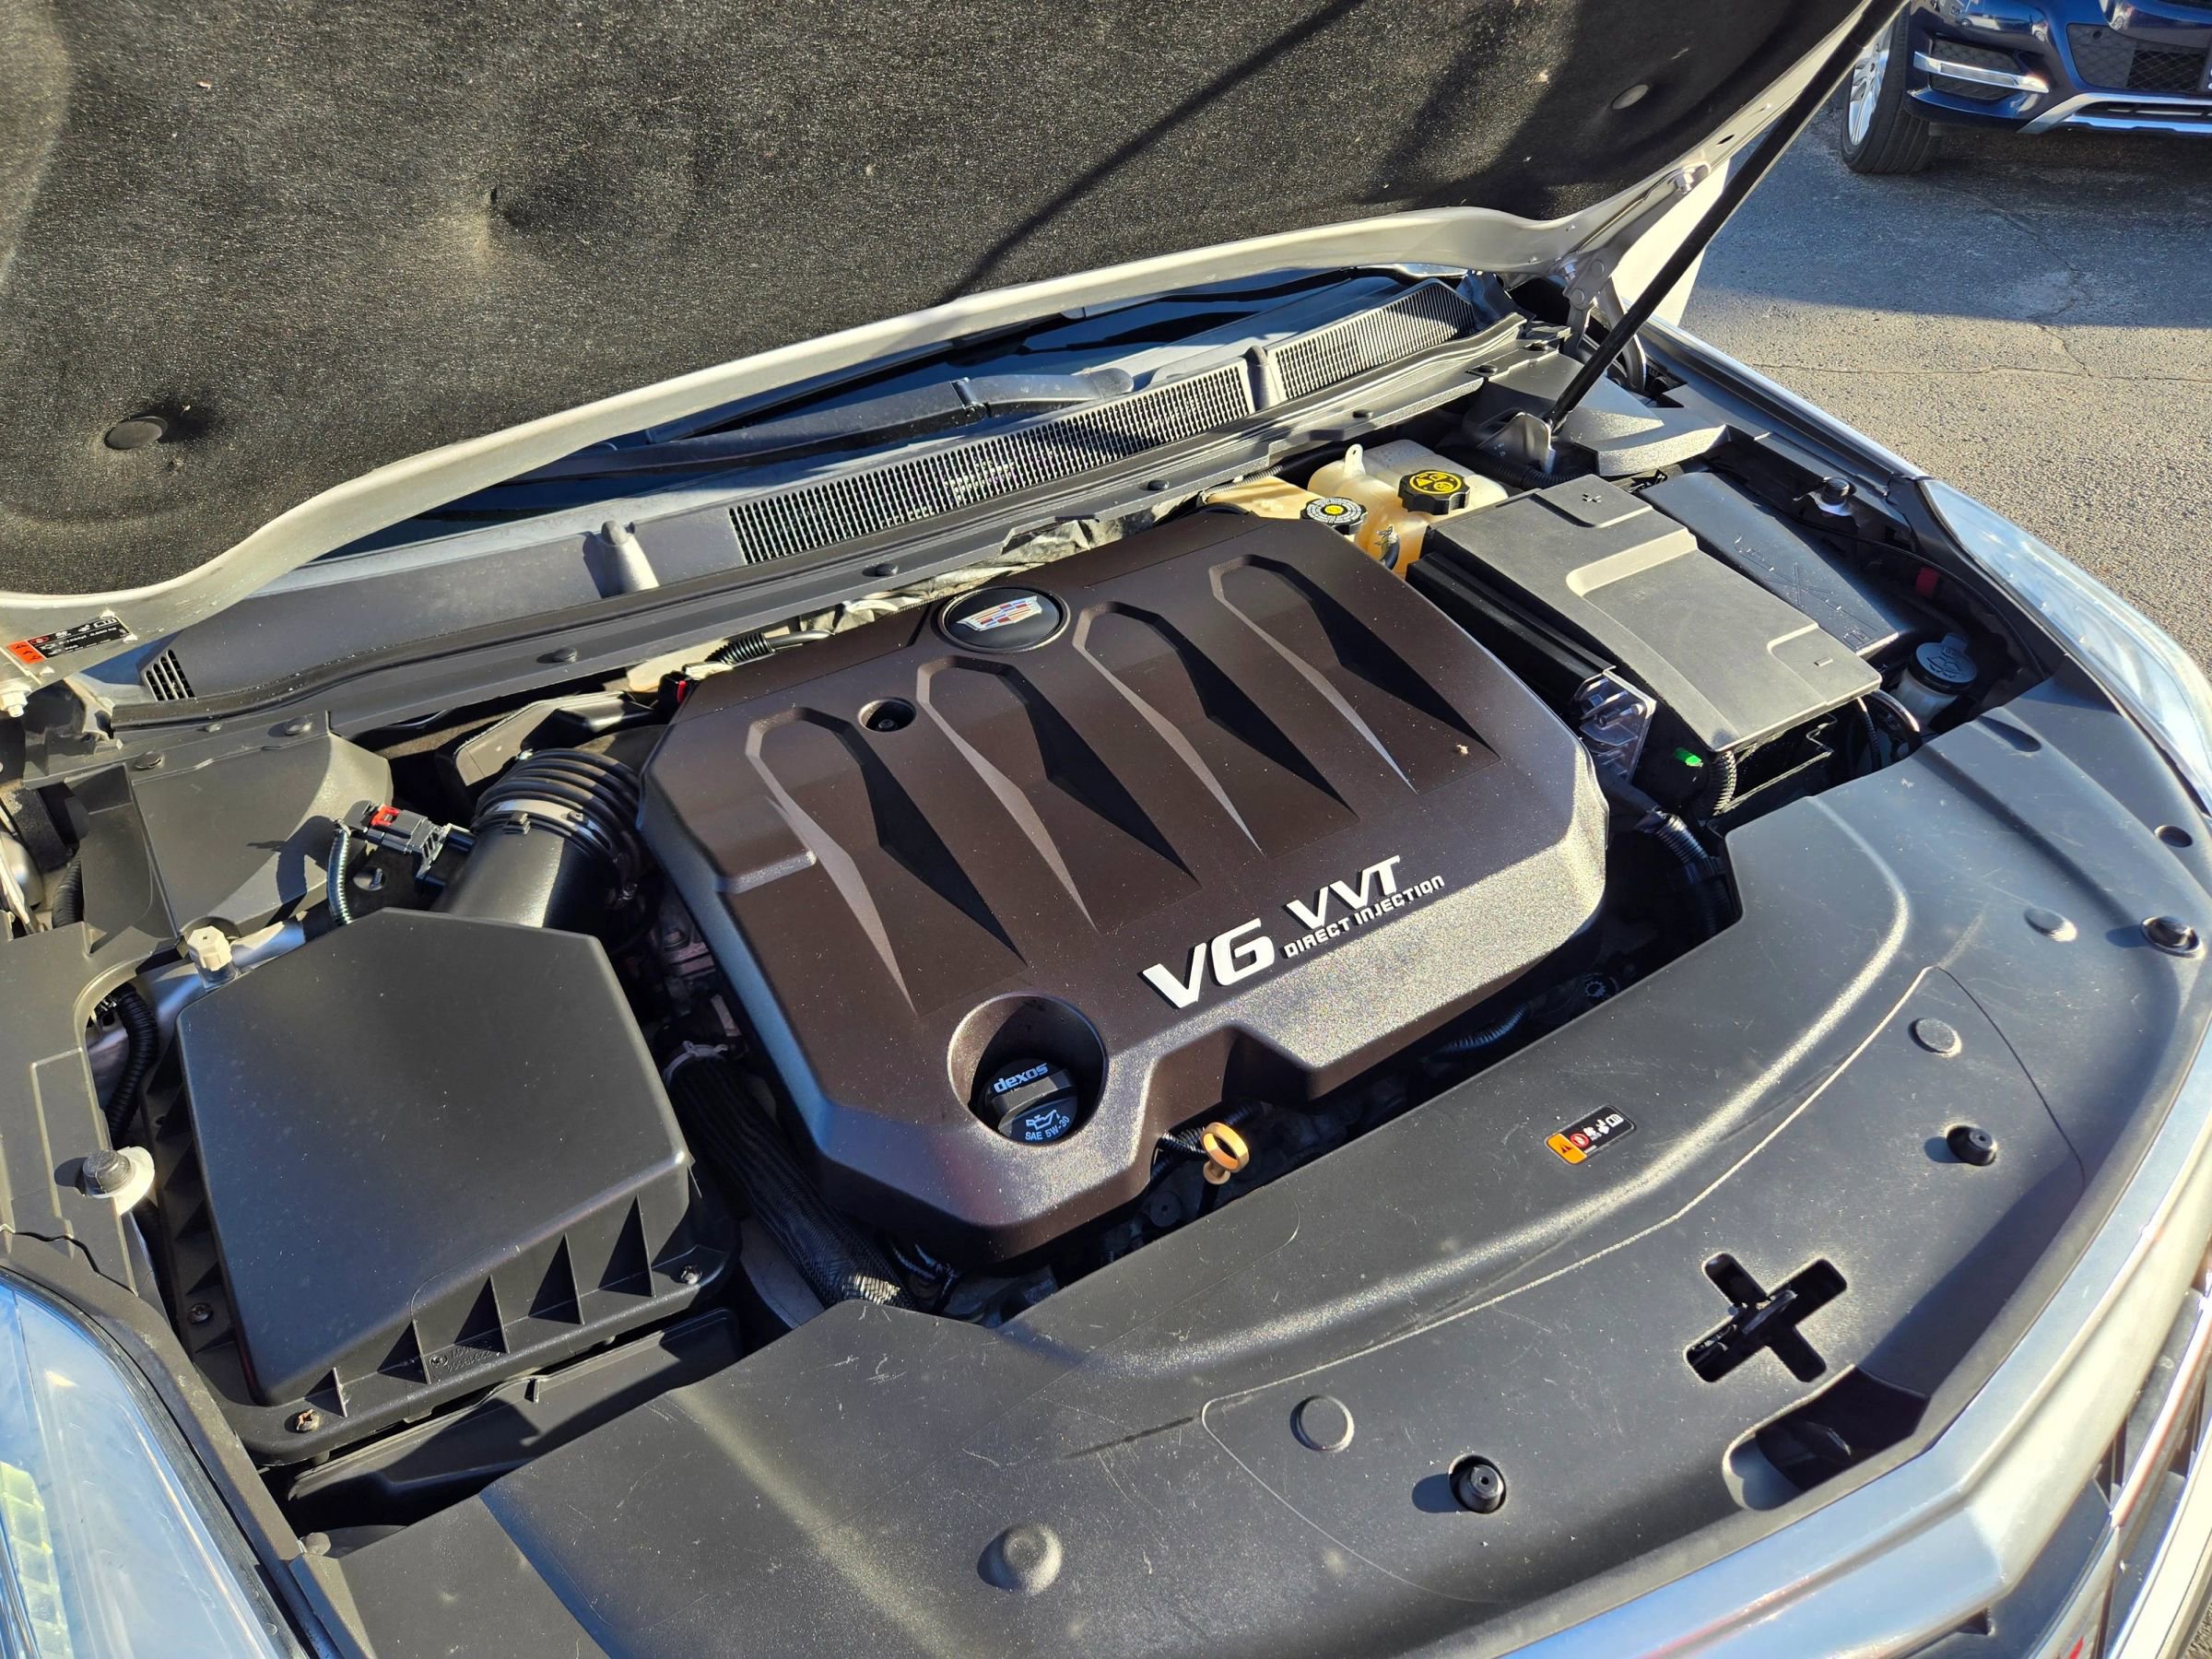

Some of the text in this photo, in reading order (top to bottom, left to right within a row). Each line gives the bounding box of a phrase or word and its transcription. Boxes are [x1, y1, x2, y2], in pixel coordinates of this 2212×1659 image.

[1143, 854, 1401, 1009] V6 VVT
[1283, 875, 1445, 959] DIRECT INJECTION
[993, 1063, 1049, 1094] dexos
[1025, 1115, 1070, 1141] SAE 5W-30
